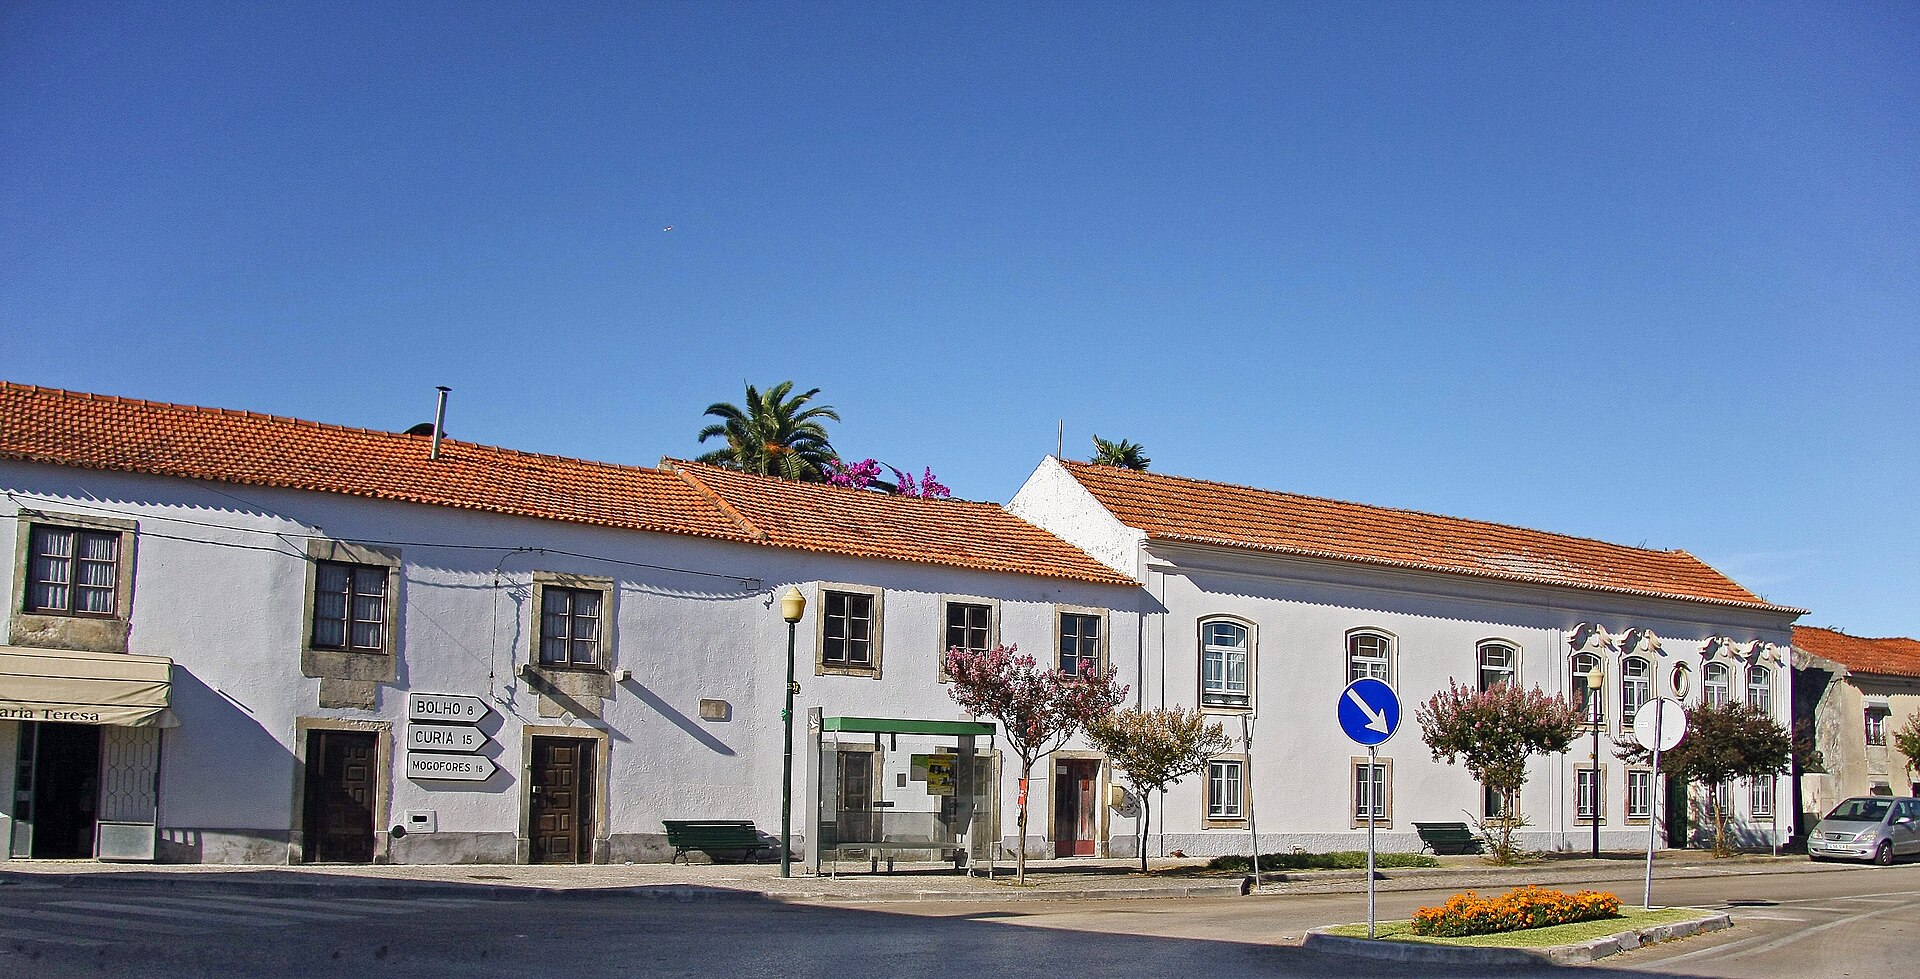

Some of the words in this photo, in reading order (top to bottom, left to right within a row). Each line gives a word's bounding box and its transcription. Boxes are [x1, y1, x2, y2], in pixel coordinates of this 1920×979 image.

[0, 707, 34, 719] aria
[41, 709, 99, 721] Teresa
[416, 701, 461, 715] BOLHO
[467, 705, 474, 716] 8
[415, 731, 454, 745] CURIA
[462, 735, 473, 745] 15
[412, 761, 471, 773] MOGOFORES
